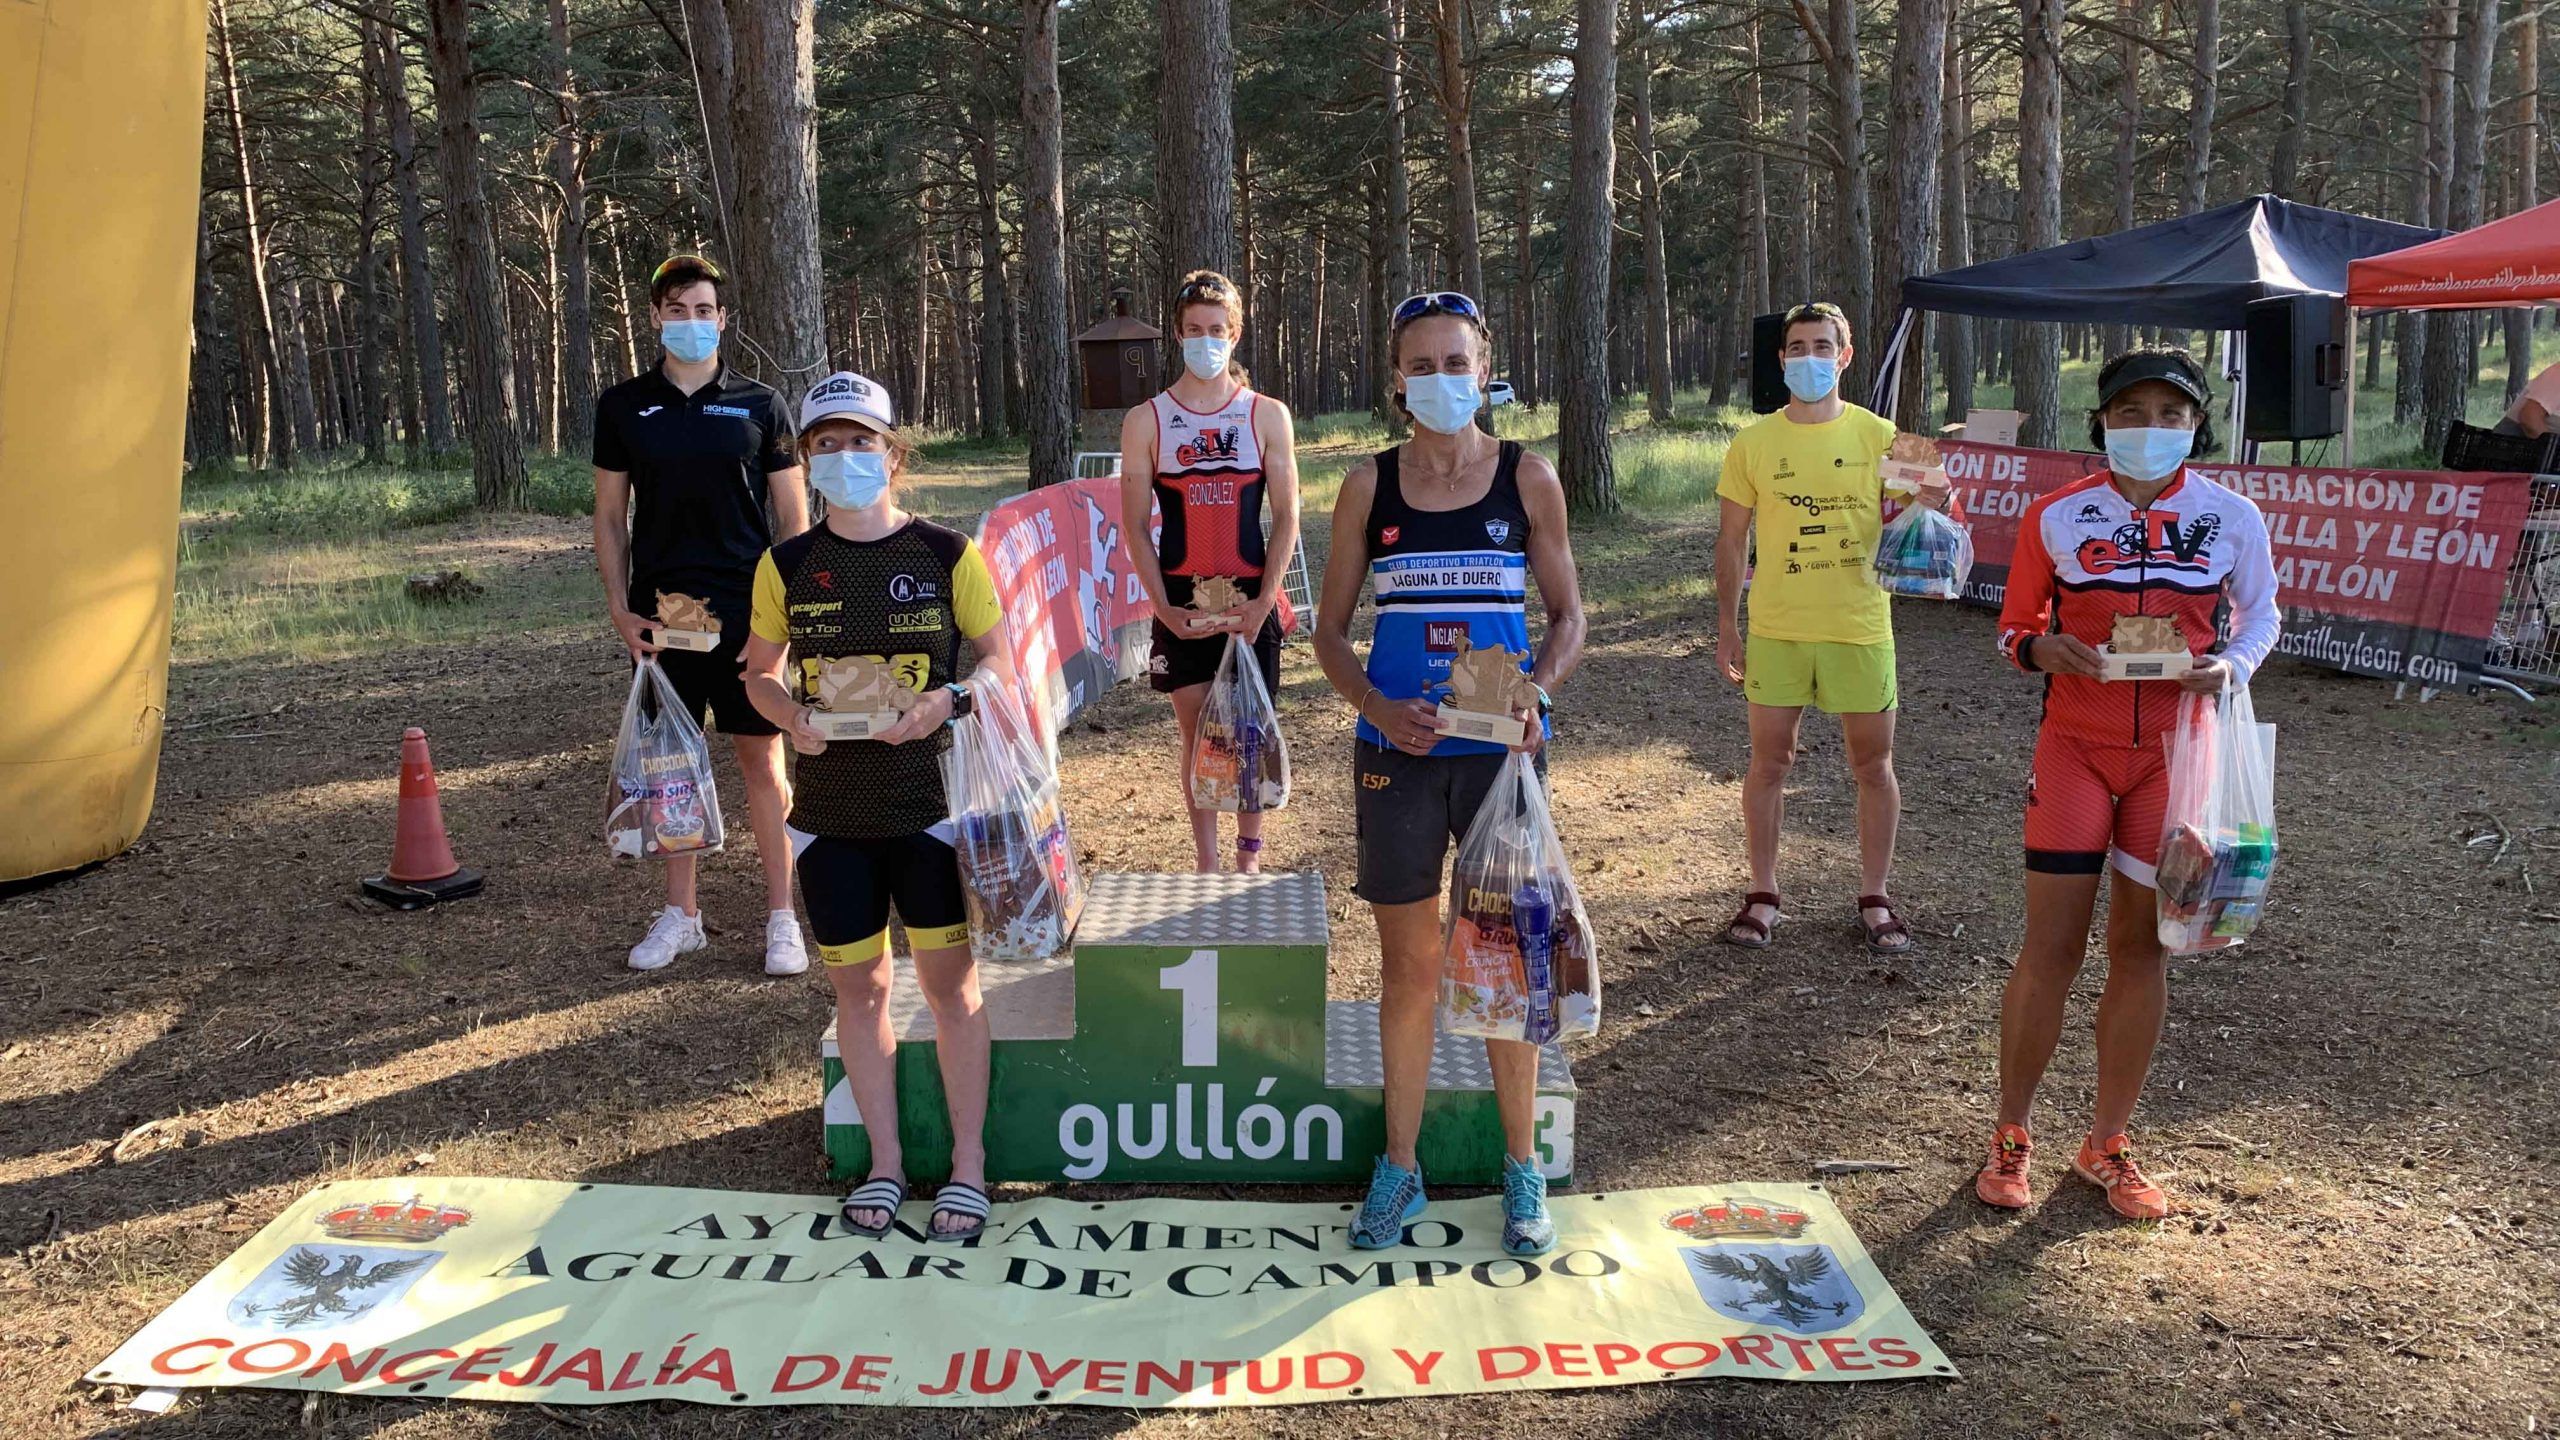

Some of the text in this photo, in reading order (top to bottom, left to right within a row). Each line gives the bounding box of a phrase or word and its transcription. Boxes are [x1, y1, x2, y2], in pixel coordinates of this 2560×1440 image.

[1991, 454, 2028, 482] DE
[1188, 477, 1235, 506] GONZÁLEZ
[2425, 482, 2485, 519] DE
[1035, 508, 1057, 549] DE
[2354, 520, 2382, 554] Y
[2386, 518, 2500, 569] LEÓN
[1042, 546, 1069, 601] LEÓN
[1388, 560, 1407, 571] CLUB
[1410, 557, 1460, 568] DEPORTIVO
[1392, 571, 1501, 587] LAGUNA DE DUERO
[916, 582, 936, 593] VIII
[1362, 772, 1391, 790] ESP
[1159, 948, 1218, 1067] 1
[1058, 1076, 1344, 1180] gullón
[1534, 1096, 1575, 1180] 3
[490, 1246, 1621, 1299] AGUILAR DE CAMPOO
[150, 1333, 1922, 1397] CONCEJALÍA DE JUVENTUD Y DEPORTES
